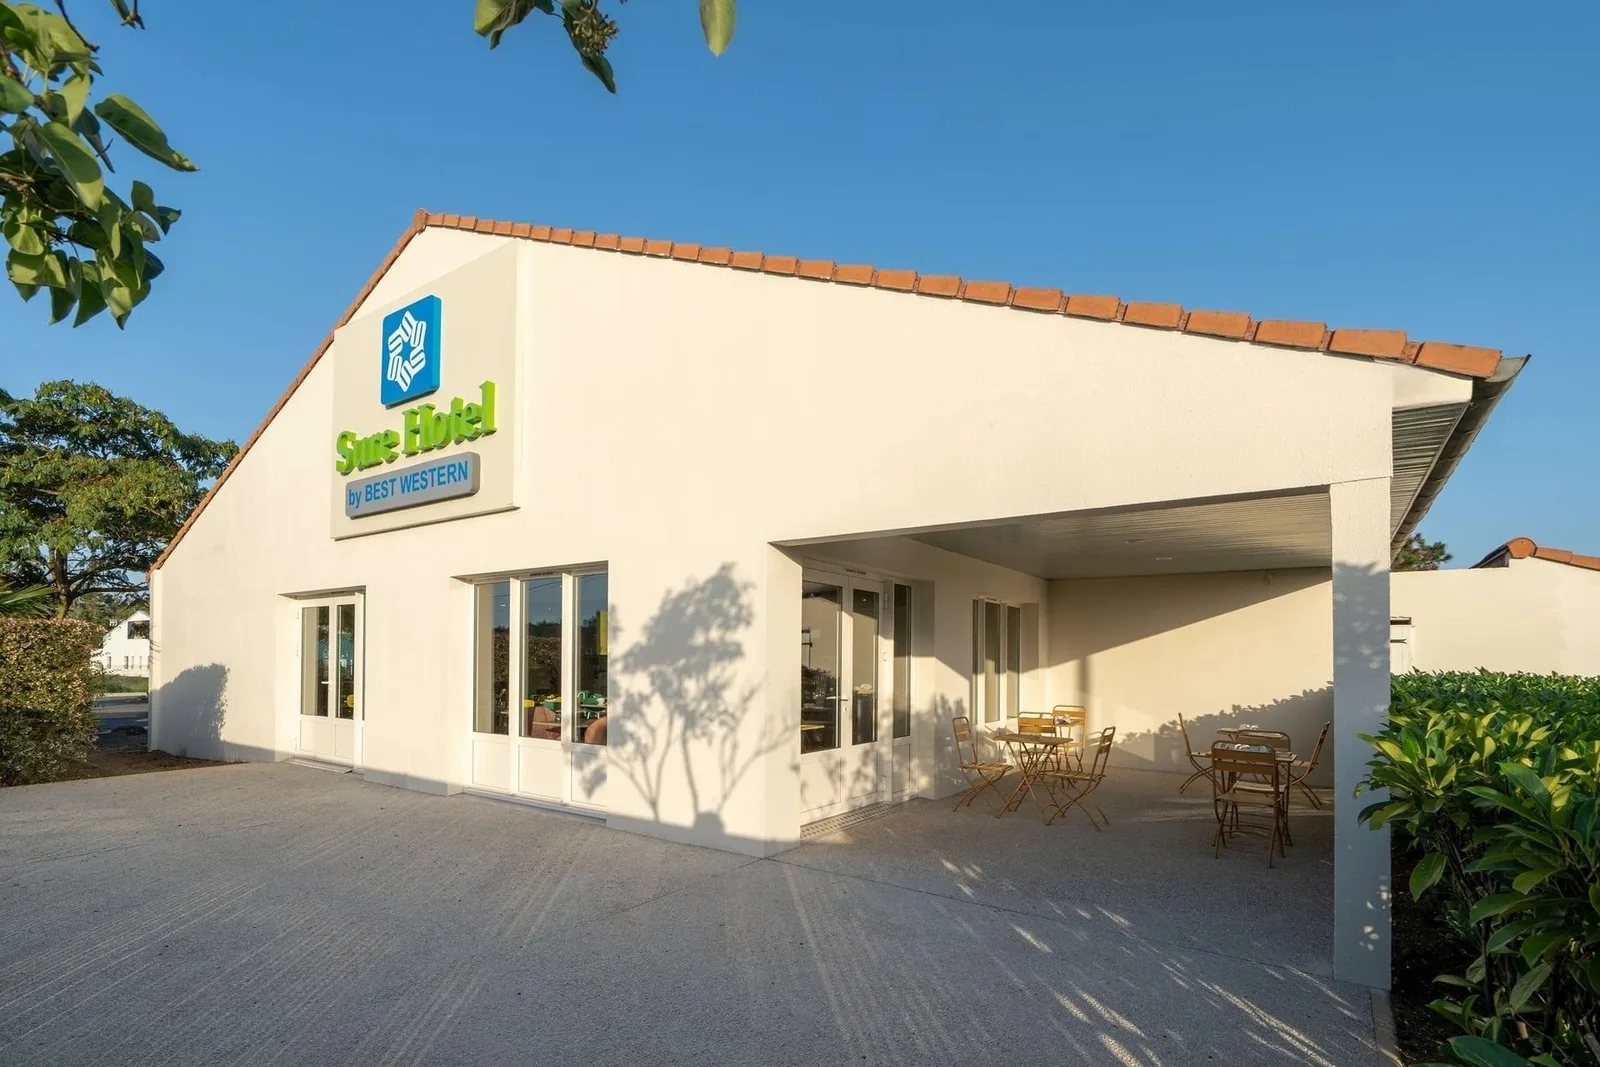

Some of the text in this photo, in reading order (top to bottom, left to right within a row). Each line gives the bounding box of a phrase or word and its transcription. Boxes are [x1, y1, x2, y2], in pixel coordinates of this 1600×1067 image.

[336, 380, 497, 474] Sure Hotel
[348, 460, 469, 508] by BEST WESTERN
